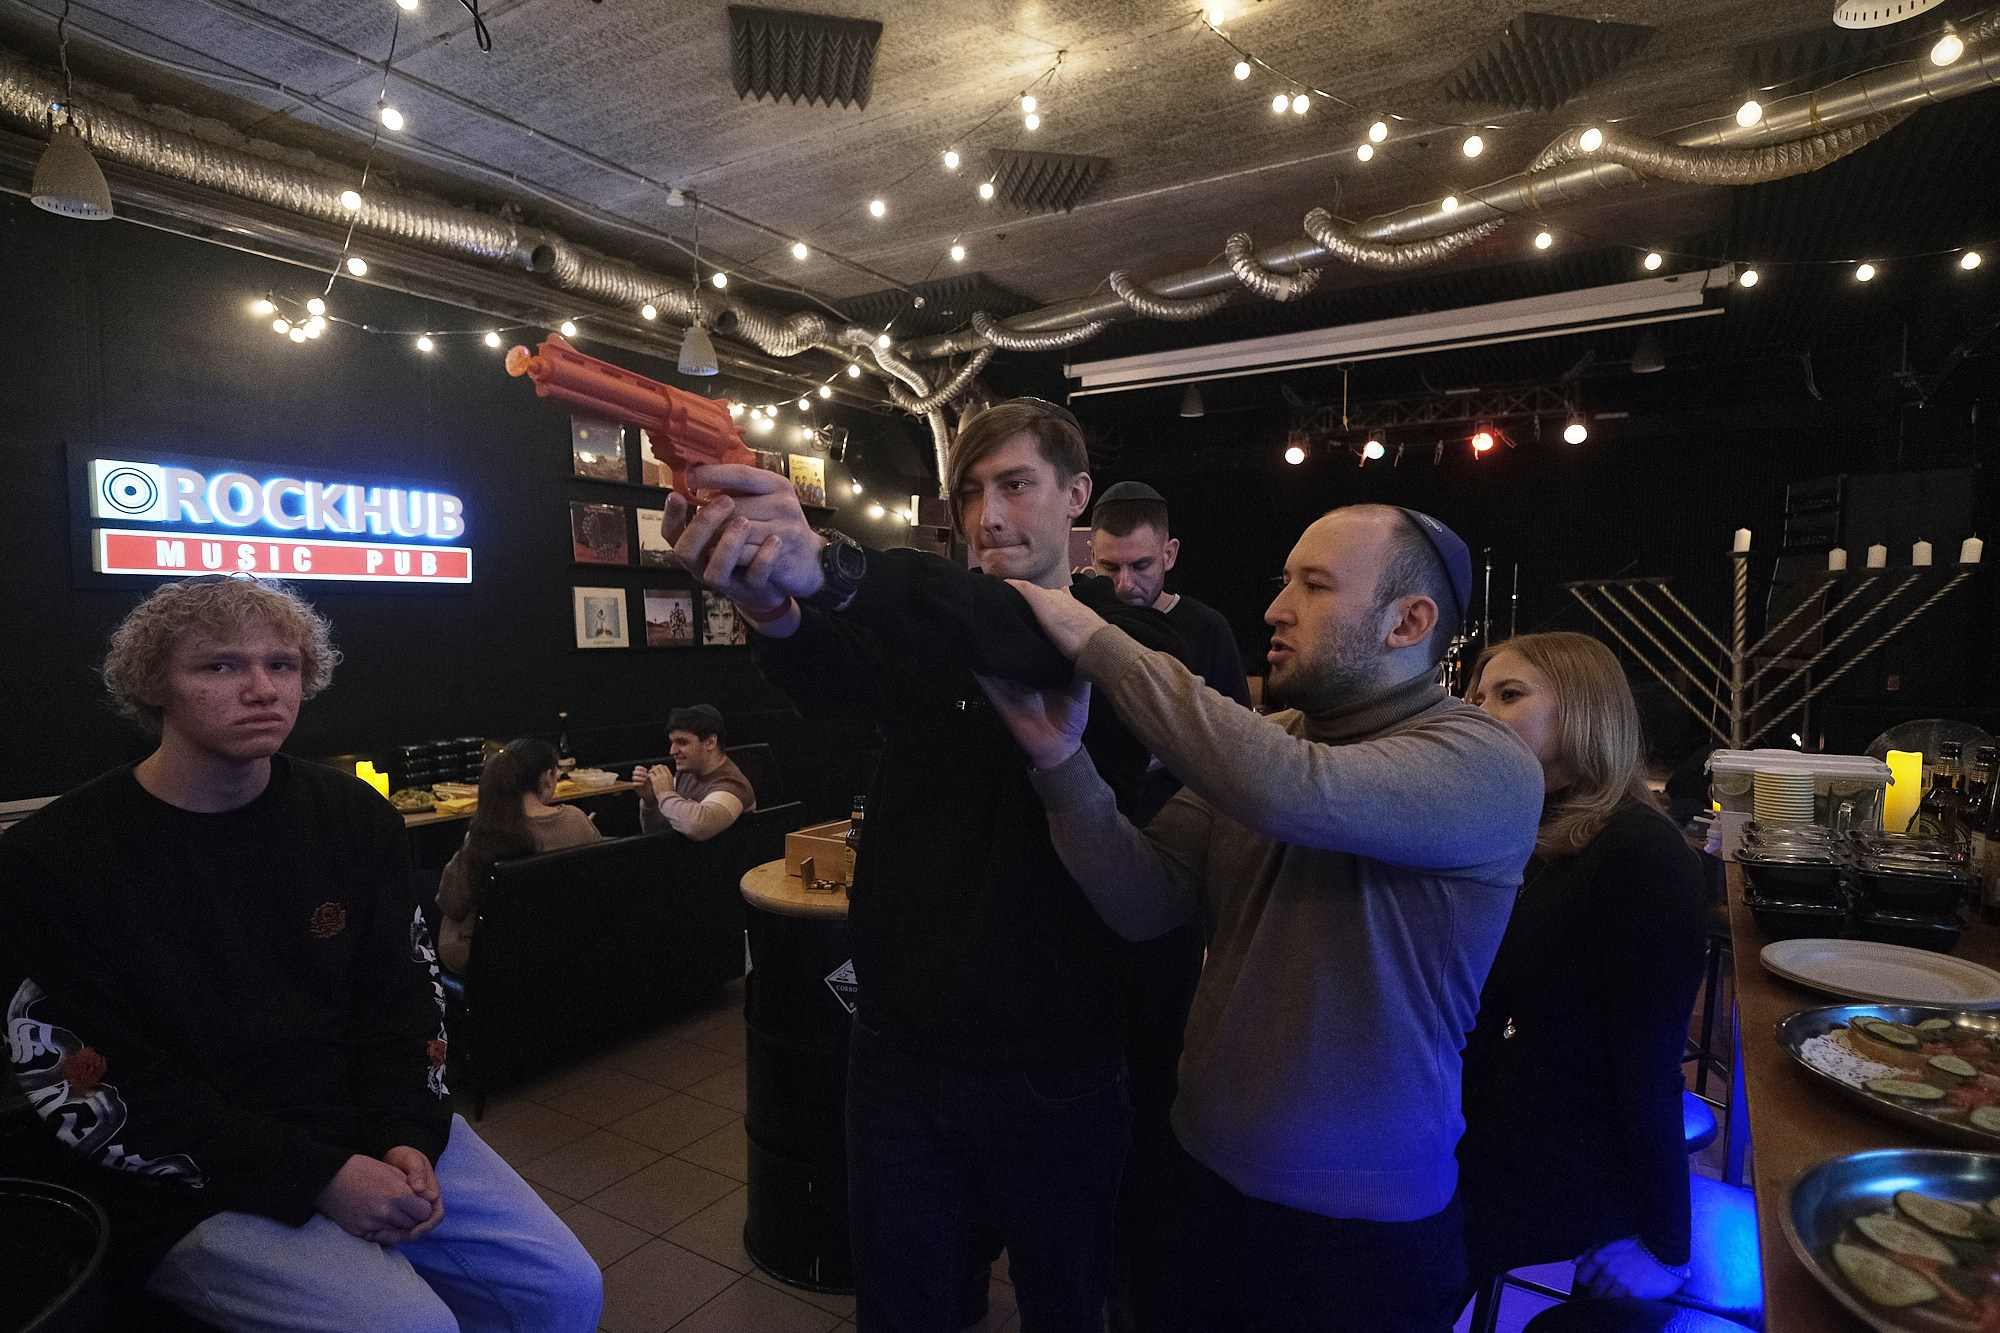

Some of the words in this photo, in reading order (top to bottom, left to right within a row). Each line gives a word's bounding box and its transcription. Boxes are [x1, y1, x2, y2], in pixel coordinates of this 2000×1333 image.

[162, 467, 465, 538] ROCKHUB
[156, 539, 312, 573] MUSIC
[366, 549, 438, 576] PUB
[836, 985, 857, 993] CORRO
